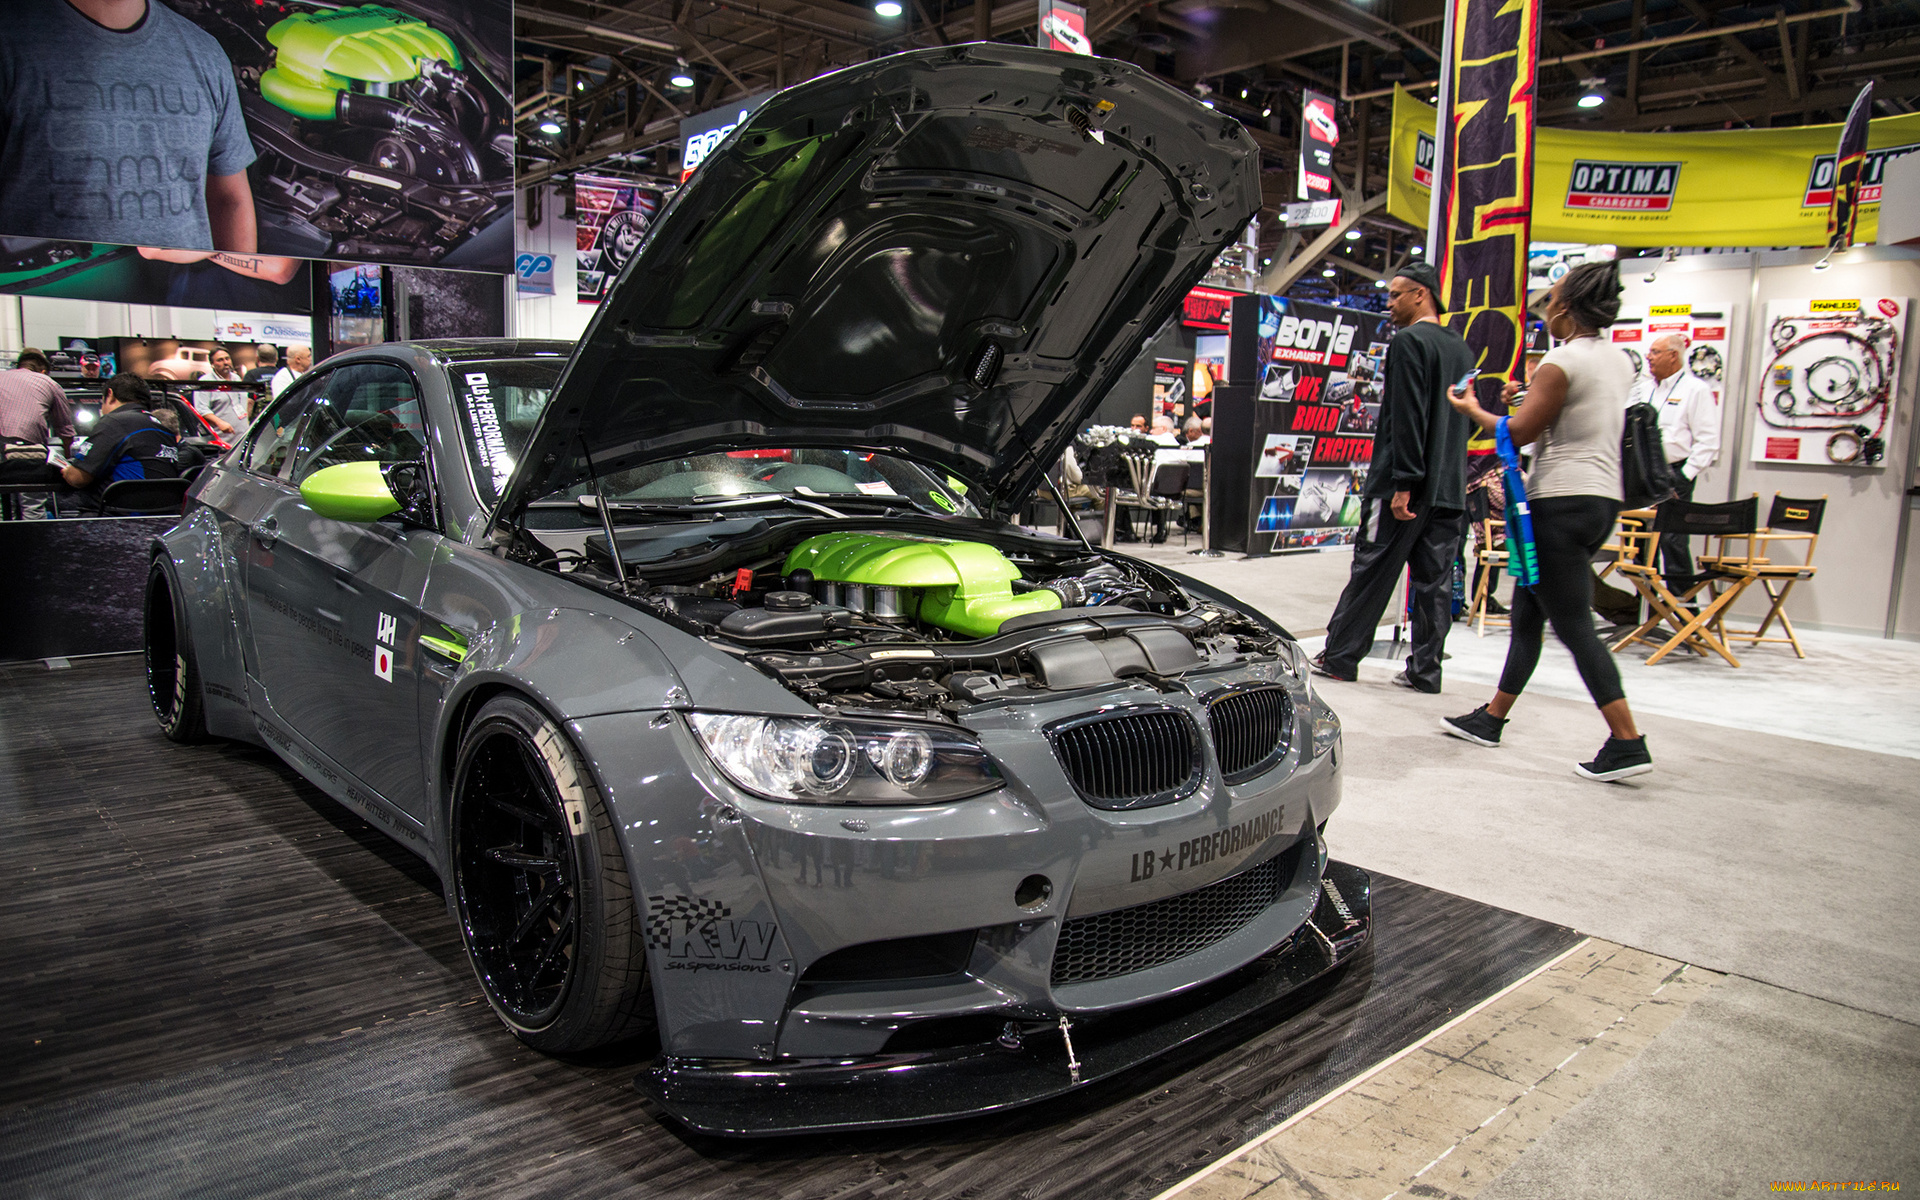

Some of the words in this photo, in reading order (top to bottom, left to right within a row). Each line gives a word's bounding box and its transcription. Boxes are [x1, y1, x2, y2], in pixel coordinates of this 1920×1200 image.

[1574, 166, 1671, 192] OPTIMA
[1294, 206, 1329, 219] 22800
[1589, 197, 1649, 208] CHARGERS
[1274, 350, 1323, 363] EXHAUST
[1295, 376, 1323, 402] WE
[1291, 405, 1340, 432] BUILD
[365, 799, 391, 825] HITTERS
[392, 819, 417, 841] NITTO
[1131, 850, 1155, 883] LB
[1178, 804, 1285, 871] PERFORMANCE
[667, 918, 778, 961] KW
[664, 961, 771, 974] suspensions
